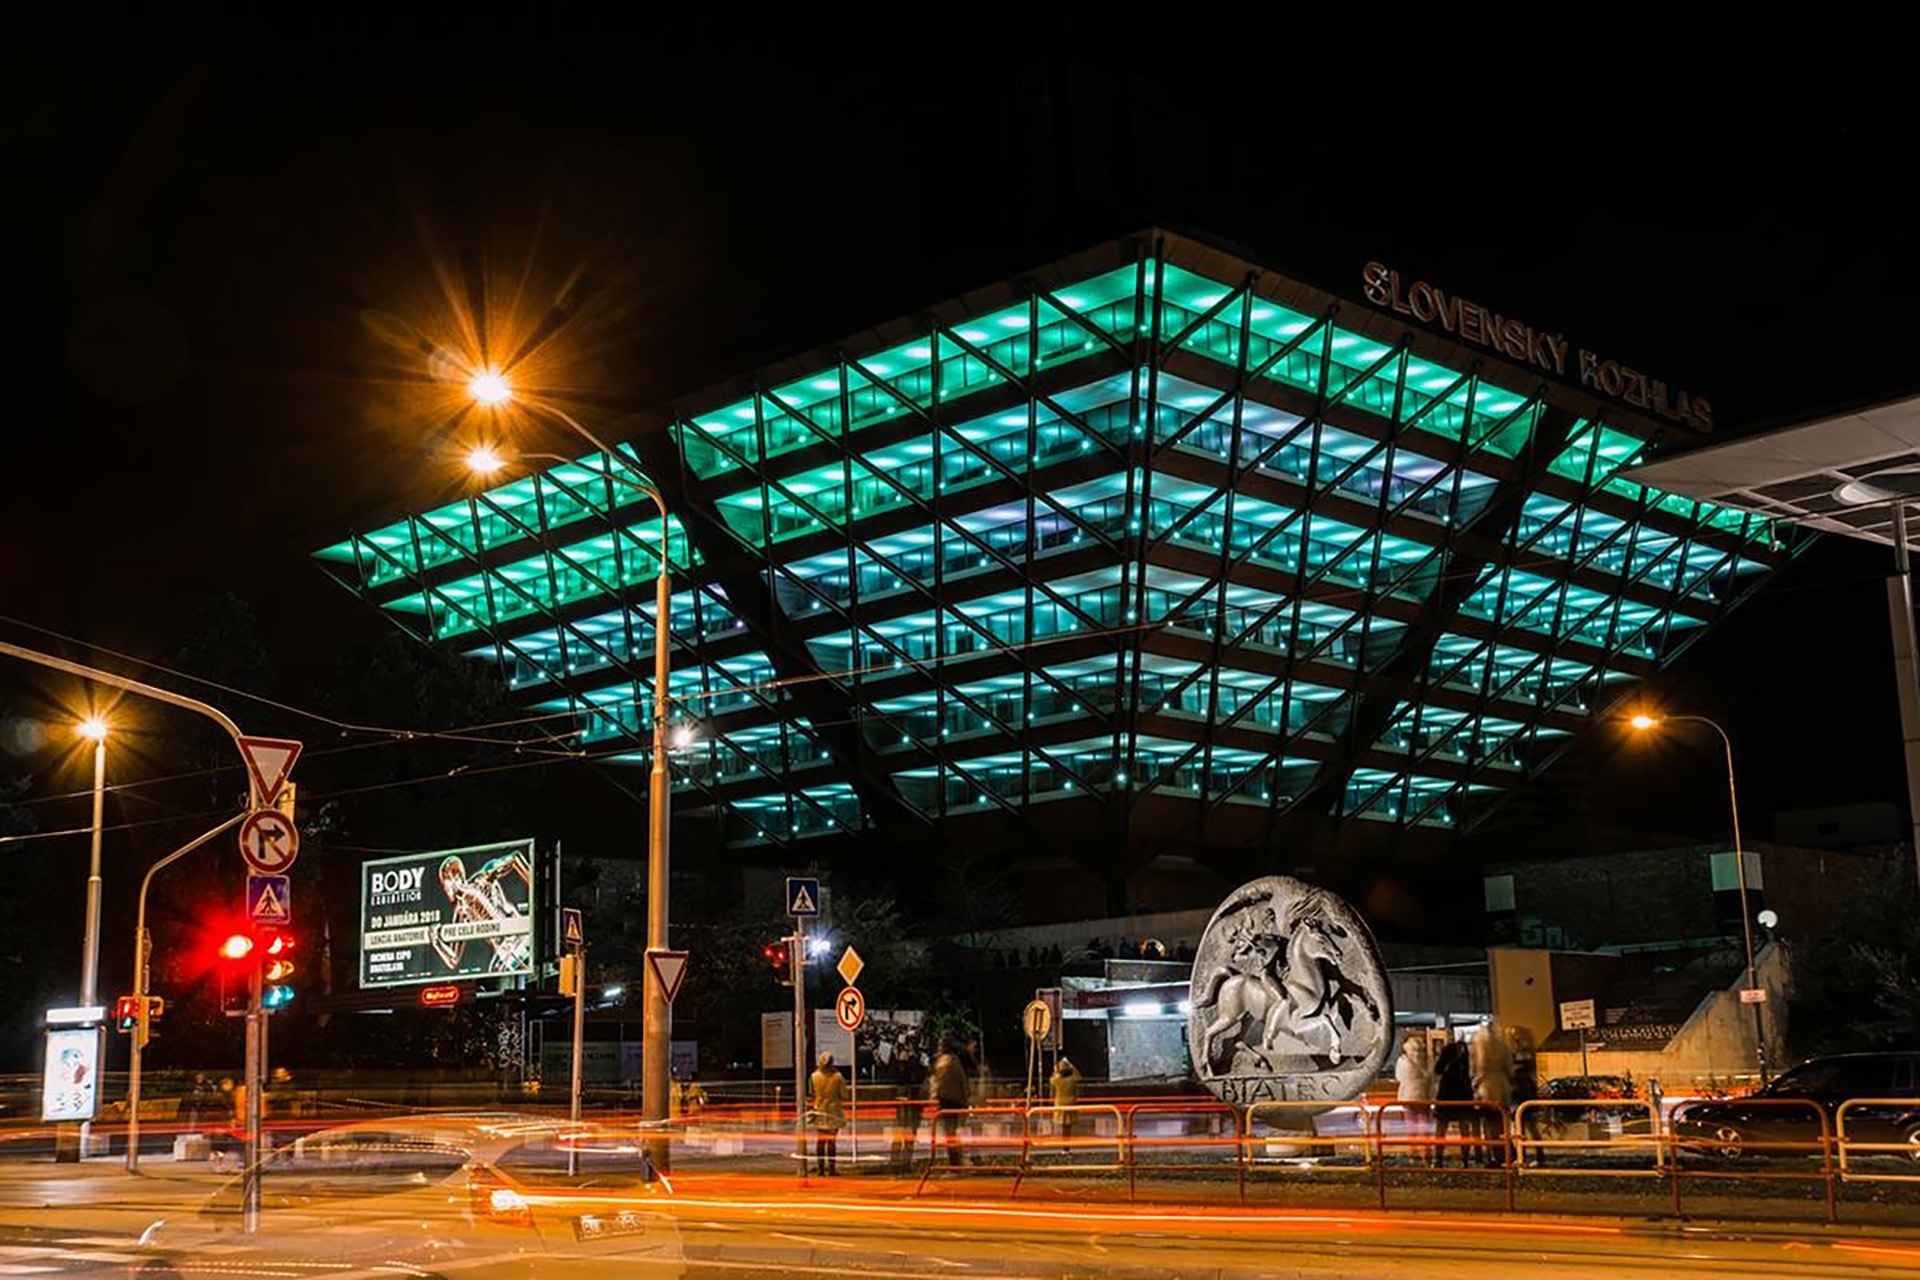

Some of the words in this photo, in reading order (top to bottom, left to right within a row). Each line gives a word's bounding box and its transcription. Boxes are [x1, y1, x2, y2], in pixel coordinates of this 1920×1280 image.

[1363, 261, 1569, 375] SLOVENSKÝ
[1579, 348, 1714, 433] ROZHLAS
[371, 867, 425, 893] BODY
